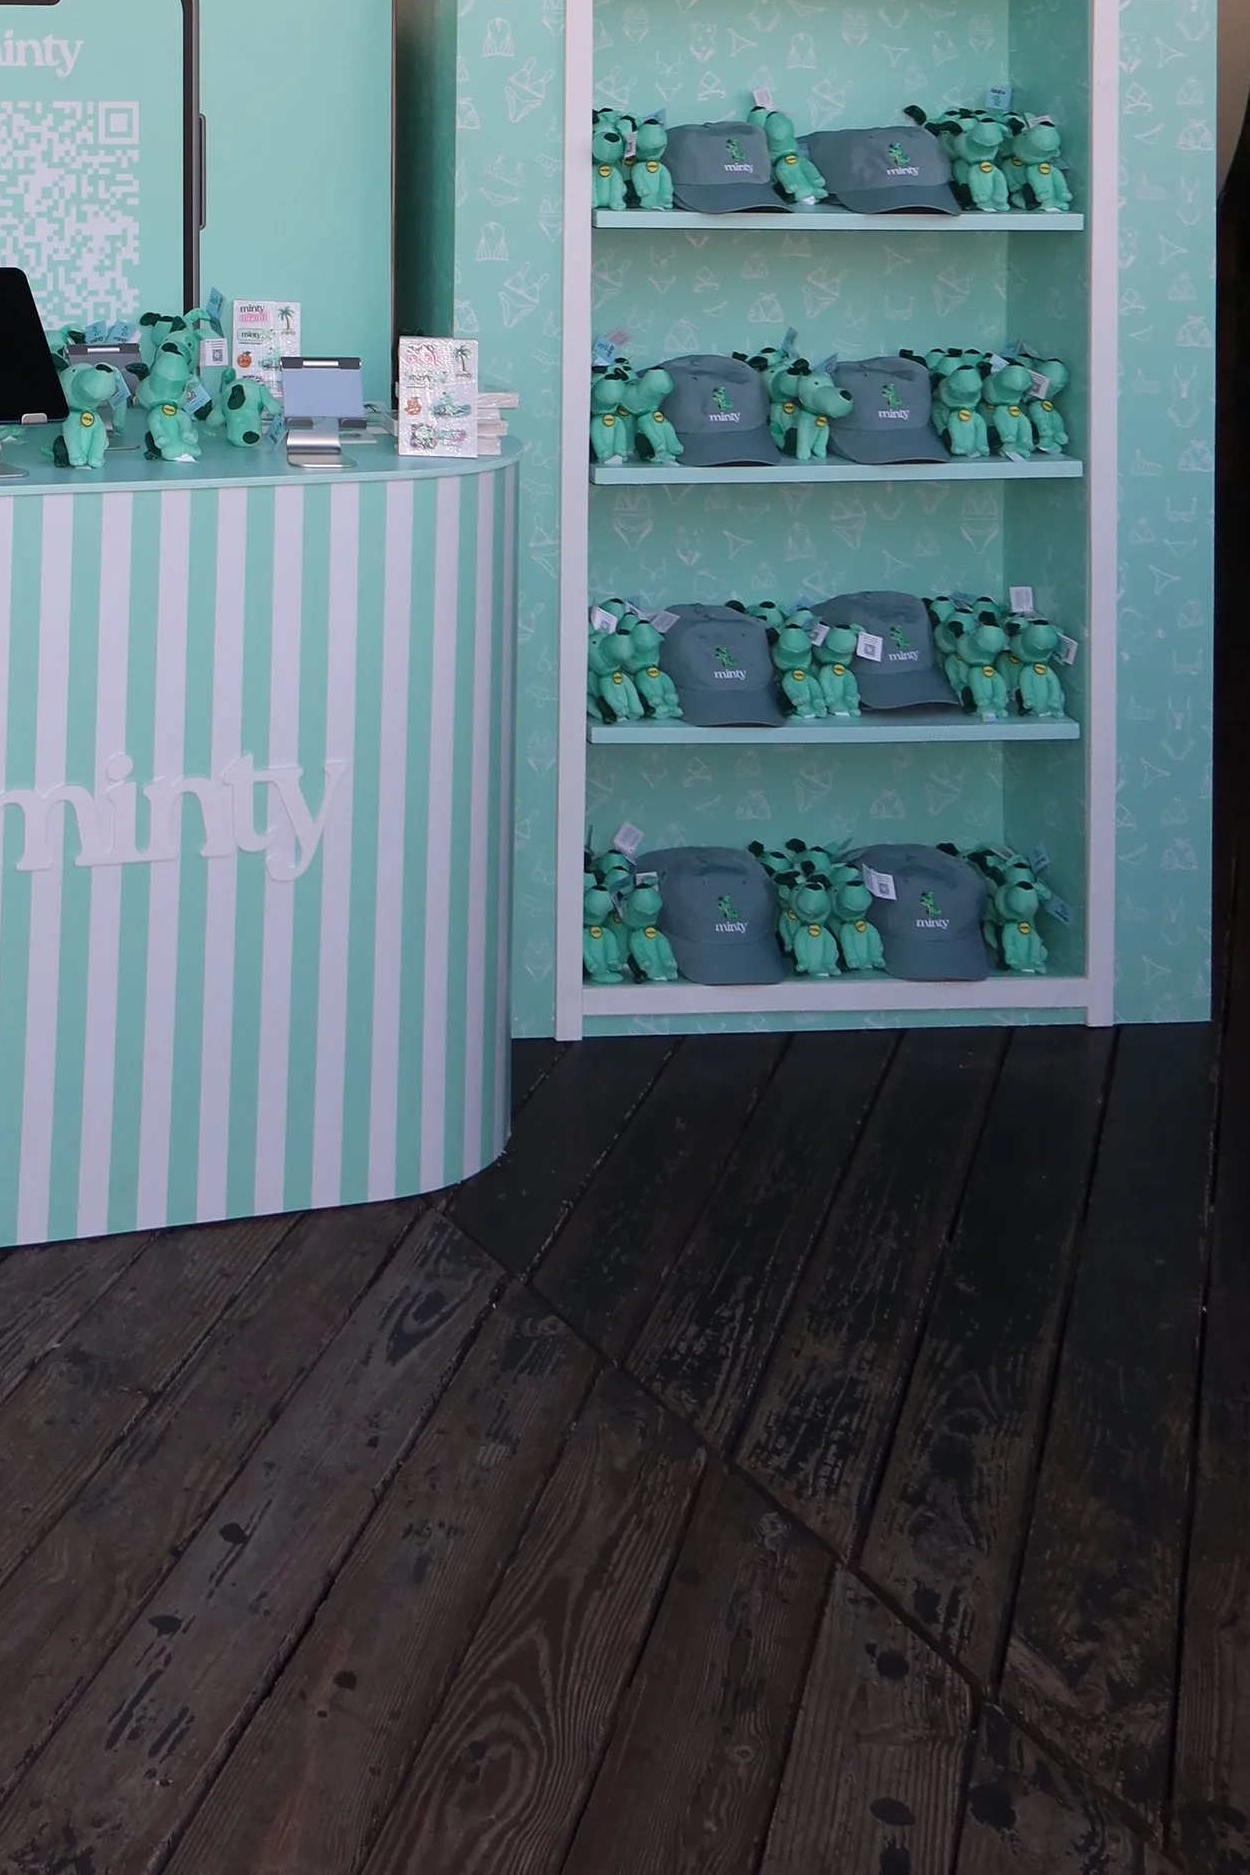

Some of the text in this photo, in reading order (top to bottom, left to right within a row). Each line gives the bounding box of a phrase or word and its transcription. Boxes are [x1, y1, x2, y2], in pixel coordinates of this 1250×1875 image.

[724, 162, 754, 174] minty
[886, 166, 919, 176] minty
[239, 304, 264, 314] minty
[709, 412, 741, 423] minty
[878, 409, 910, 420] minty
[889, 650, 919, 661] minty
[714, 669, 747, 681] minty
[715, 921, 748, 934] minty
[916, 918, 950, 930] minty
